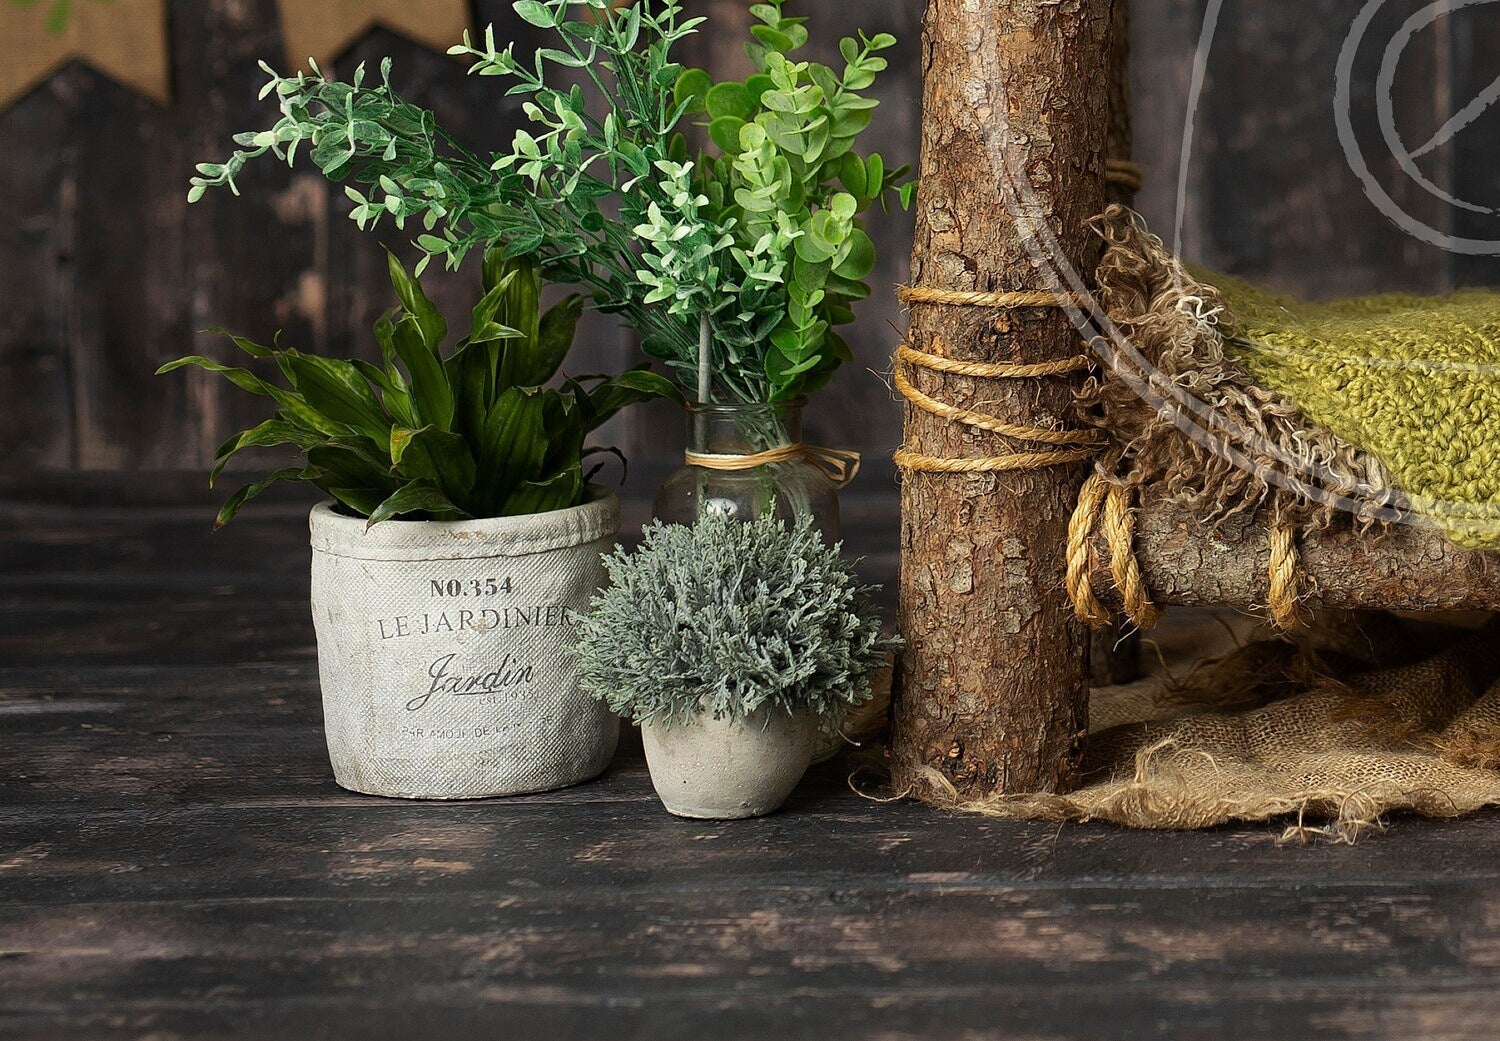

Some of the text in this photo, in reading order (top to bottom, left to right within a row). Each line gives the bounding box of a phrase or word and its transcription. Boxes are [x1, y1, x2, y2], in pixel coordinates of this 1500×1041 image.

[430, 577, 513, 598] NO.354
[377, 606, 576, 640] LE JARDINIER
[406, 653, 534, 712] Jardin
